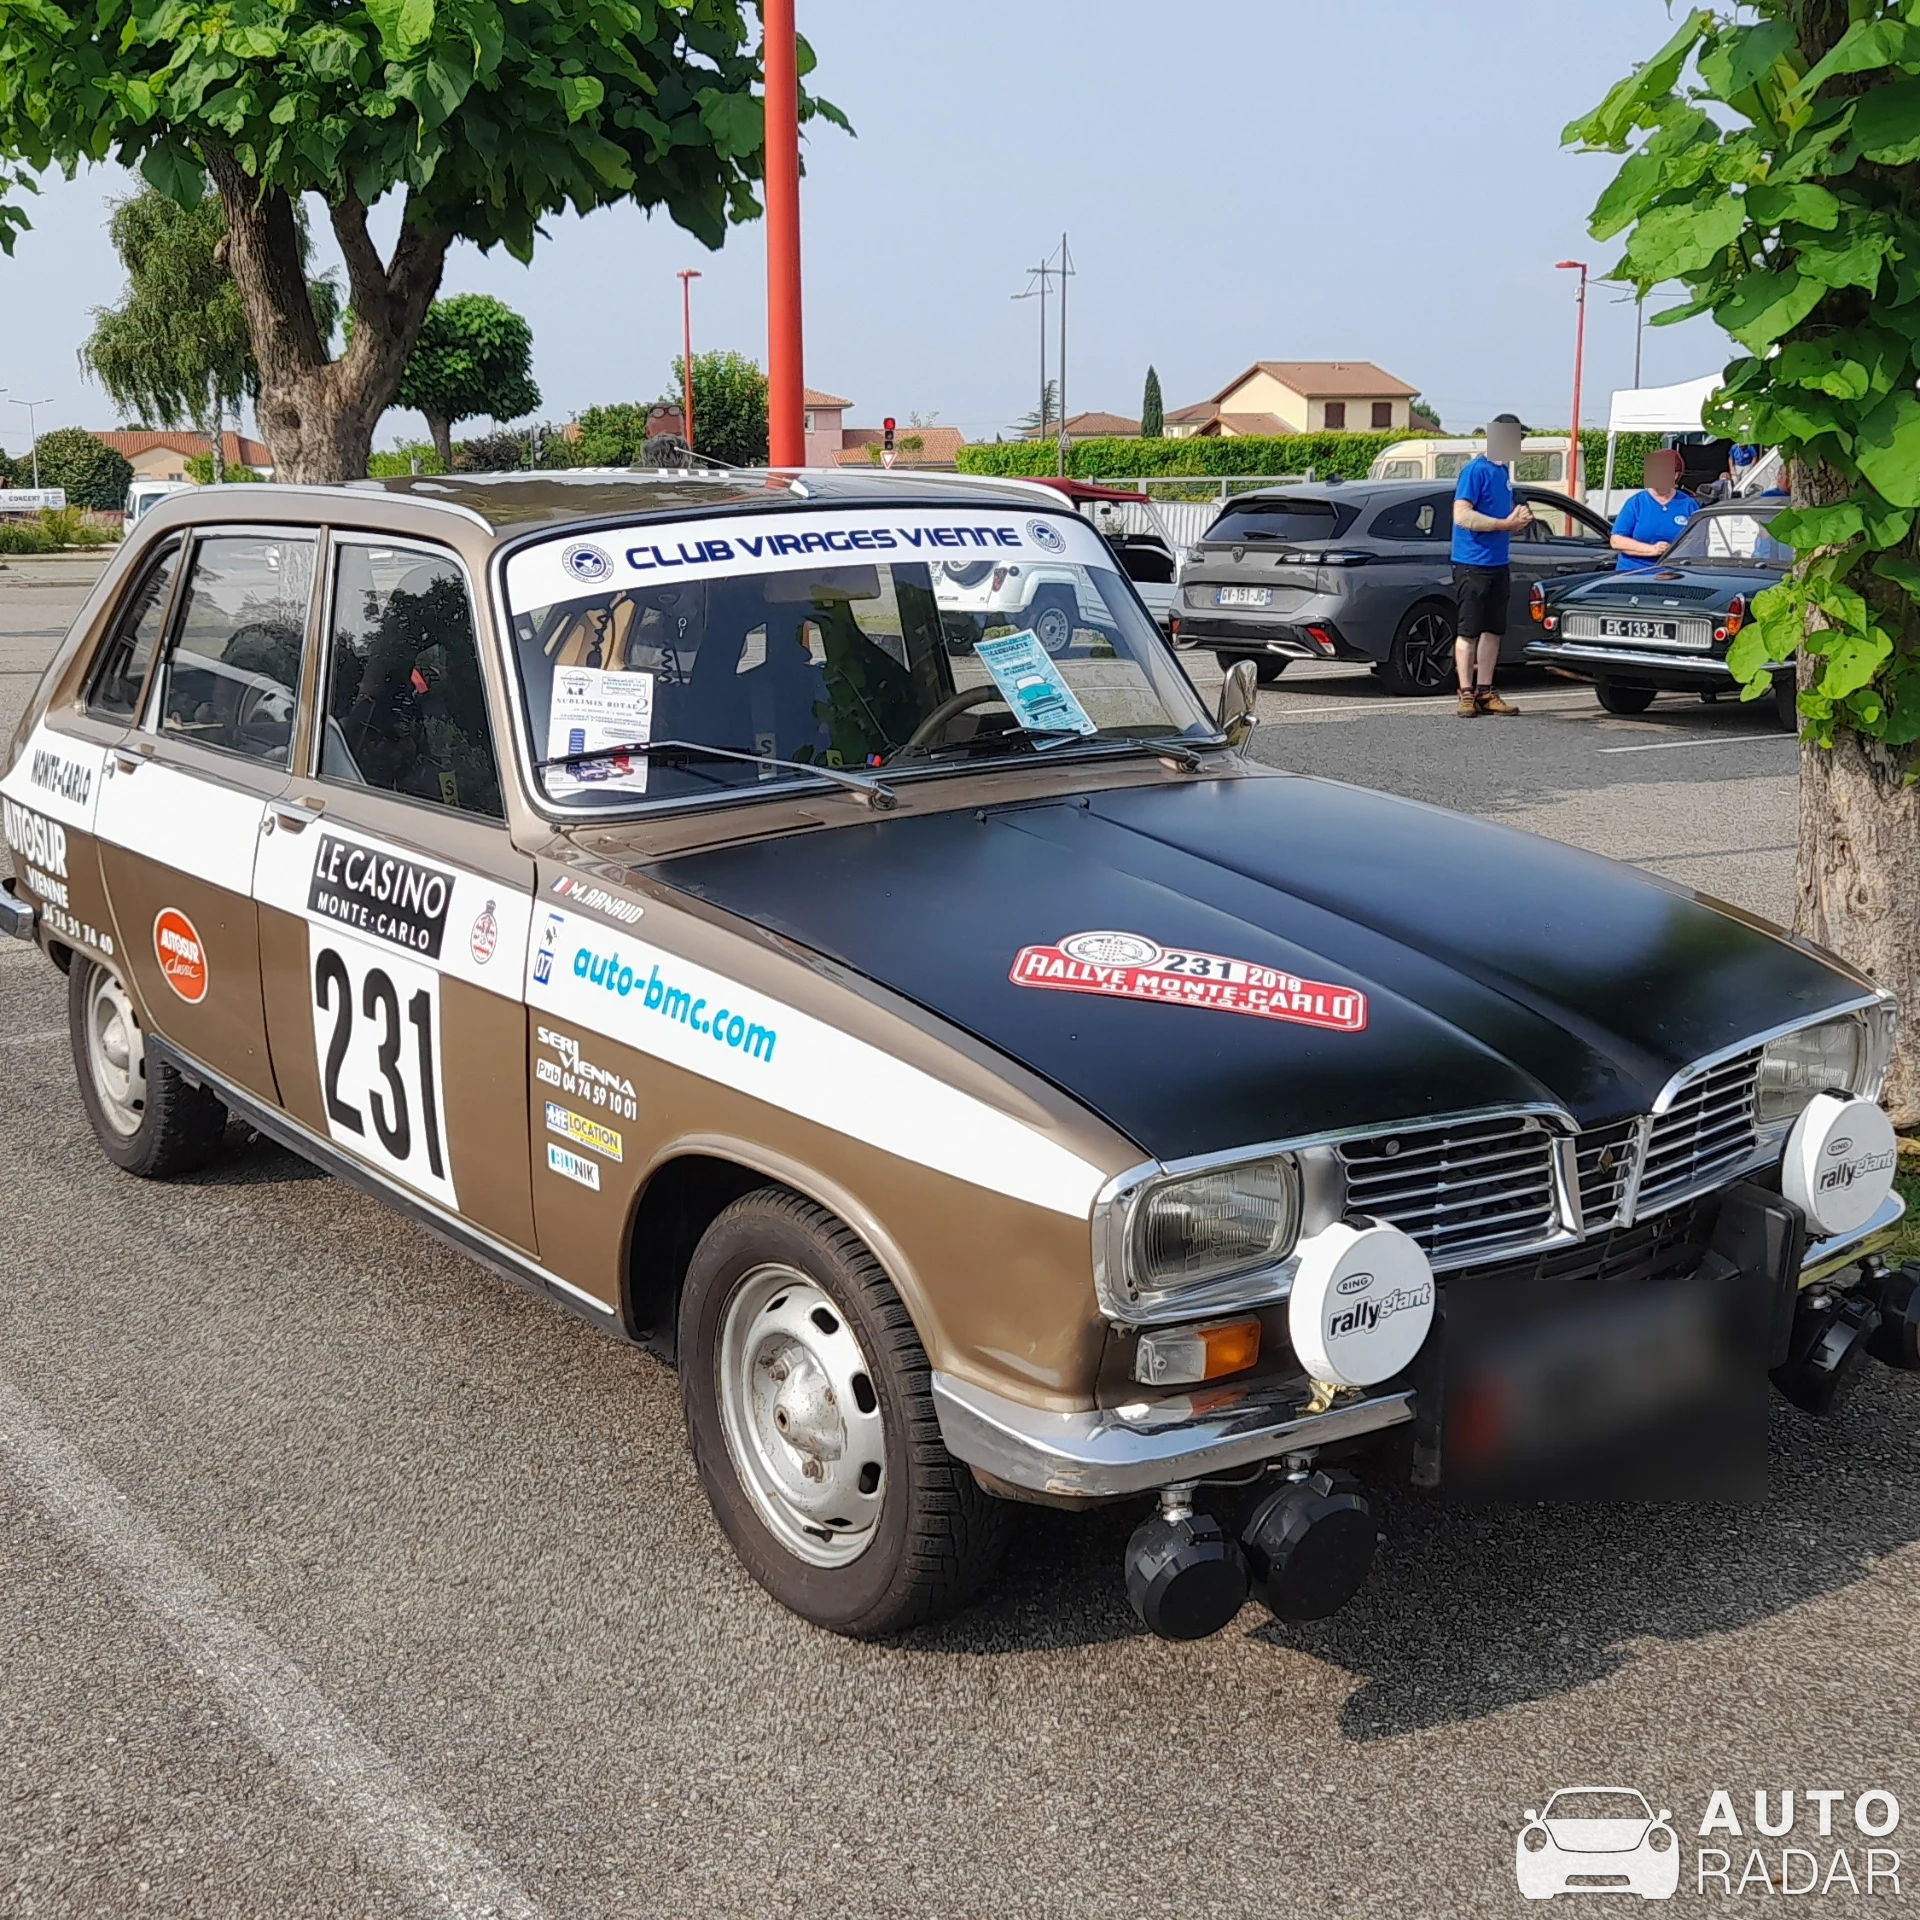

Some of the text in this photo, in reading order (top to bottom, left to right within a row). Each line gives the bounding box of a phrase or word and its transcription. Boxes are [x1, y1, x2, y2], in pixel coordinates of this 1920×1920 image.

[626, 539, 735, 570] CLUB
[735, 528, 898, 559] VIRAGES
[897, 527, 1022, 548] VIENNE
[1222, 588, 1265, 602] GV-151-JG
[1606, 620, 1669, 639] EK-133-XL
[556, 698, 603, 707] SUBLIMIS
[635, 698, 649, 716] 2
[31, 749, 92, 806] MONTE-CARLO
[3, 796, 69, 879] AUTOSUR
[25, 865, 70, 909] VIENNE
[316, 839, 447, 919] LE CASINO
[564, 881, 645, 924] M.ARNAUD
[83, 924, 98, 947] 74
[99, 932, 114, 955] 40
[160, 927, 200, 964] AUTOSUR
[535, 952, 552, 980] 07
[1164, 953, 1231, 980] 231
[1025, 953, 1353, 1020] RALLYE MONTE-CARLO
[1101, 982, 1270, 1013] HISTORIQUE
[573, 947, 777, 1063] auto-bmc.com
[537, 1026, 579, 1057] SERI
[315, 947, 446, 1181] 231
[538, 1061, 637, 1121] Pub 04 74 59 10 01
[569, 1115, 618, 1149] LOCATION
[1830, 1141, 1849, 1152] RING
[1342, 1276, 1368, 1291] RING
